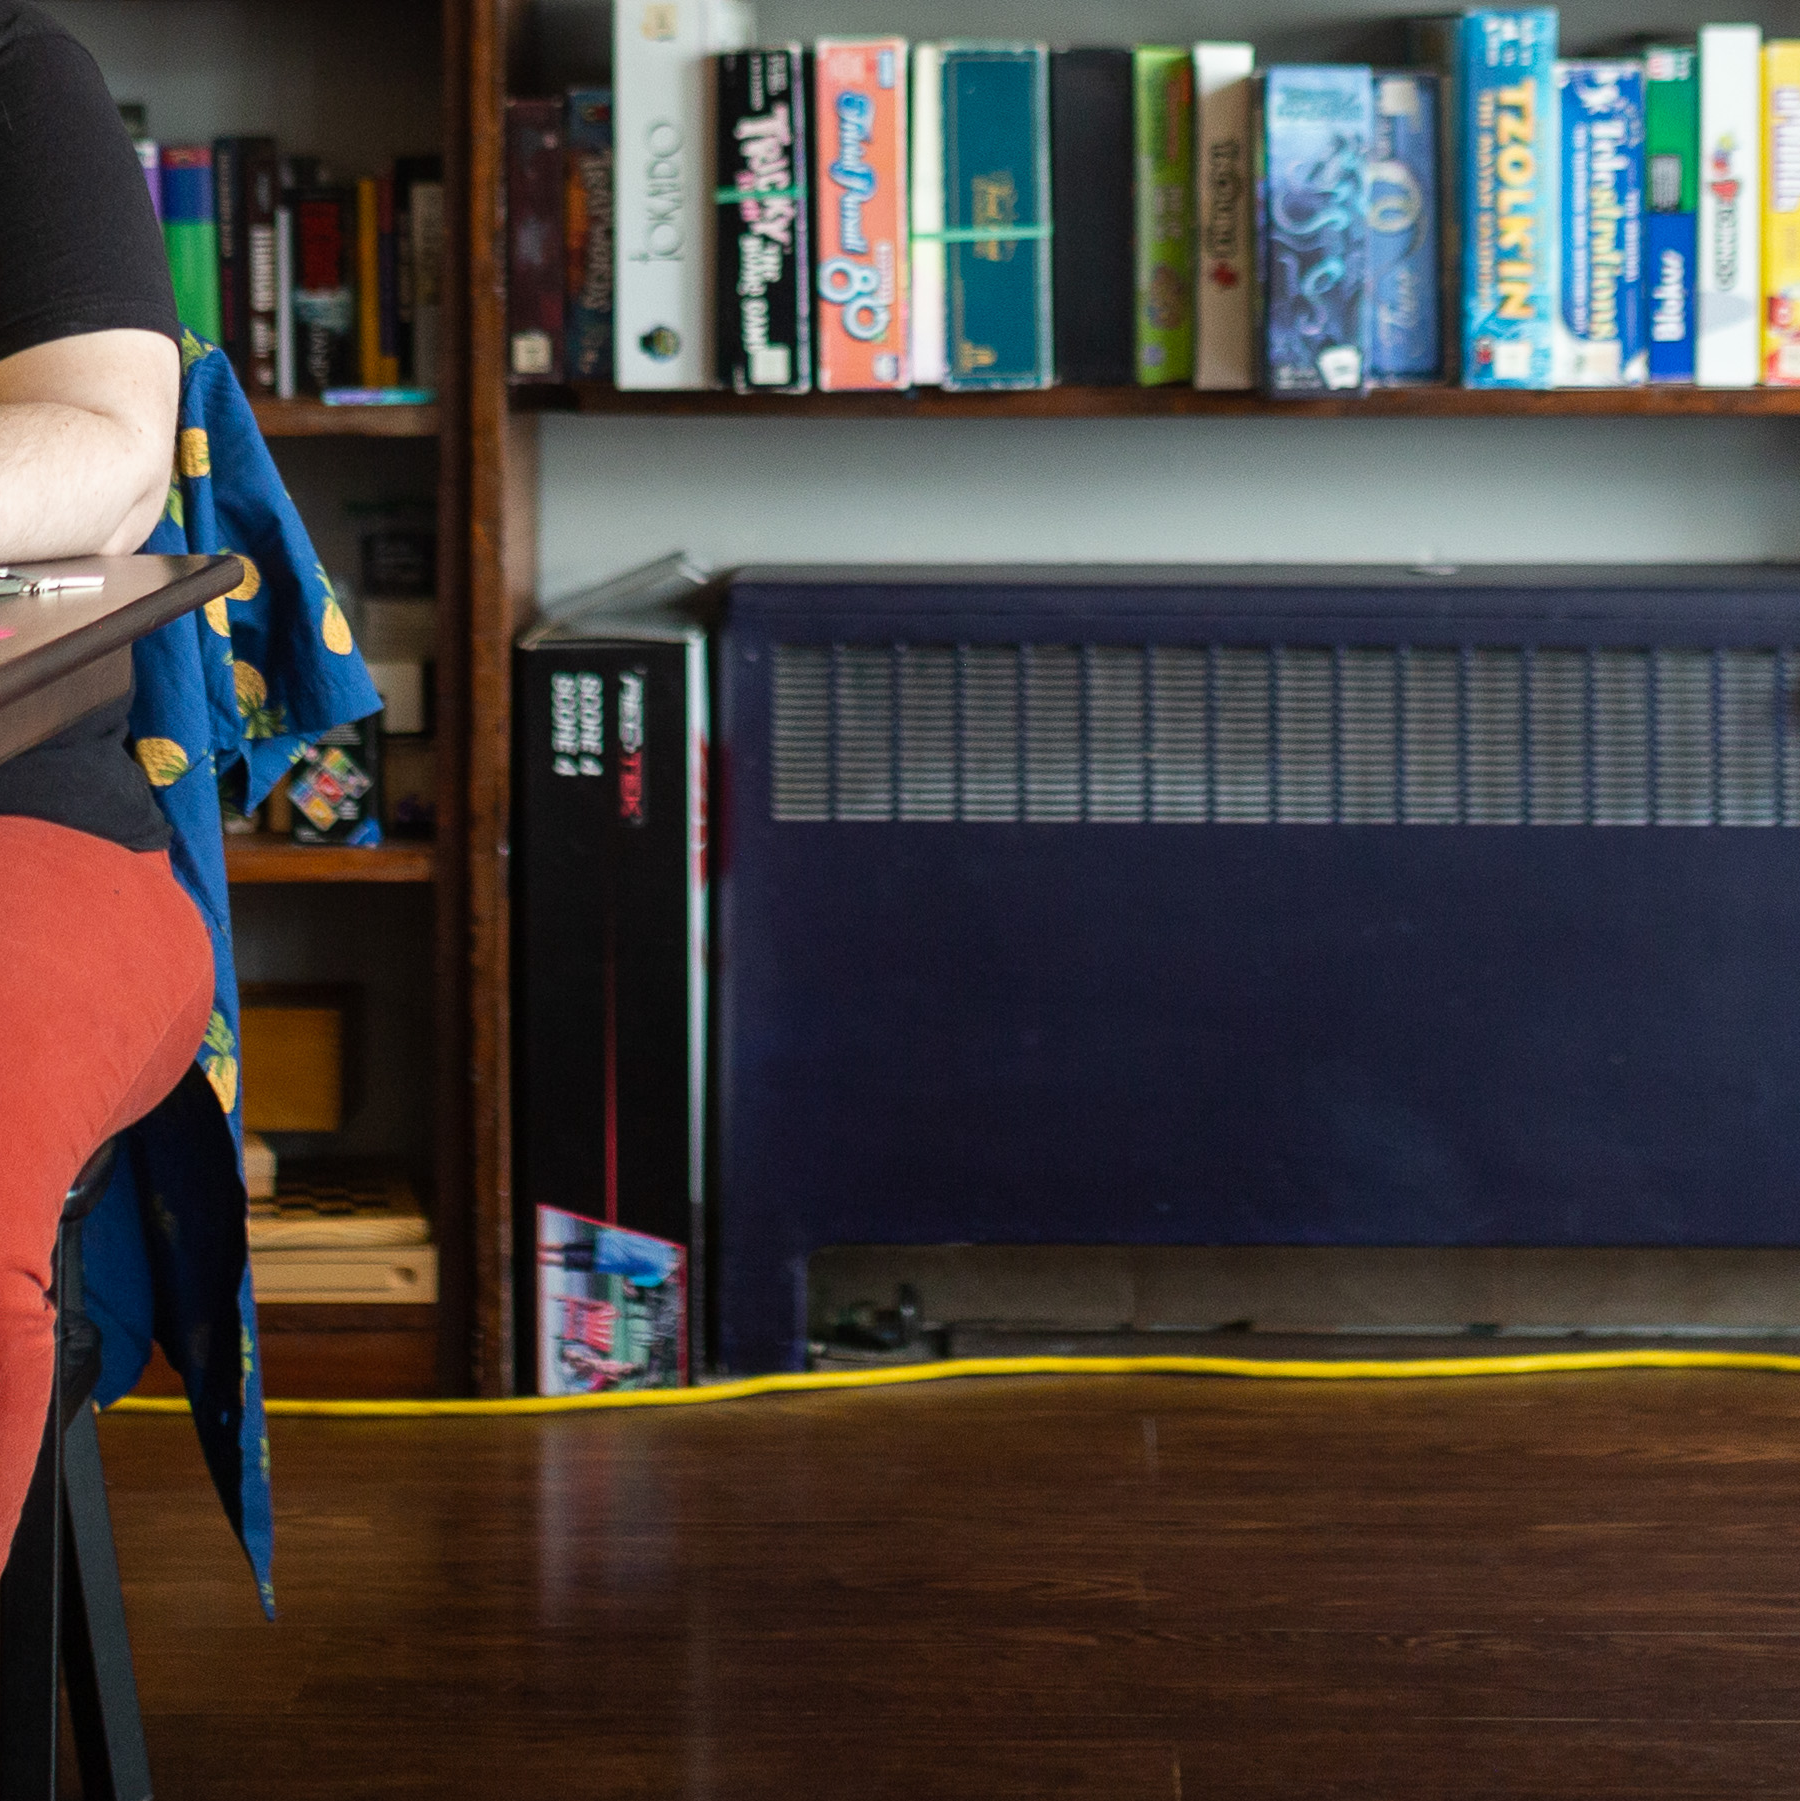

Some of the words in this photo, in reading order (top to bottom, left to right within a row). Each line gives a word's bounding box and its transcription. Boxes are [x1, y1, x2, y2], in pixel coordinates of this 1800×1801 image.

[1494, 78, 1537, 320] TZOLK'IN
[552, 674, 578, 754] SCORE
[577, 674, 603, 754] SCORE
